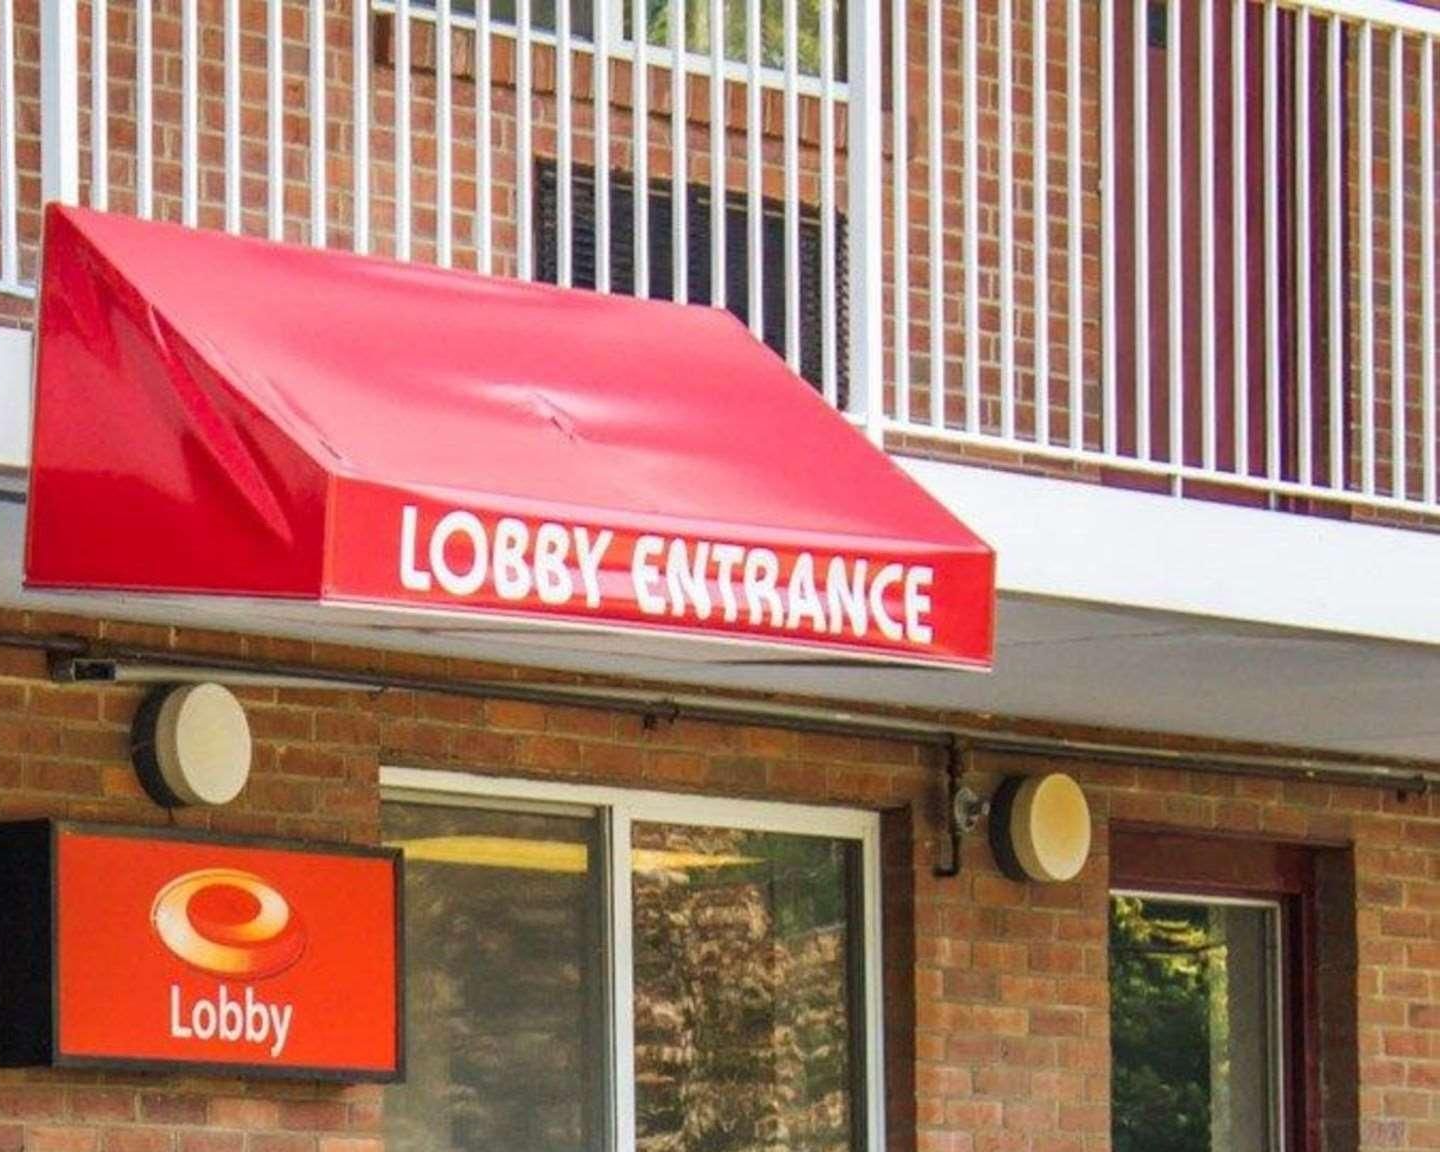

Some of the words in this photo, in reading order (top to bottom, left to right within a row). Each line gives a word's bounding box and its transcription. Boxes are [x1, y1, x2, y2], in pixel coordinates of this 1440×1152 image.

[399, 504, 613, 609] LOBBY
[631, 535, 934, 645] ENTRANCE
[170, 984, 293, 1059] Lobby
